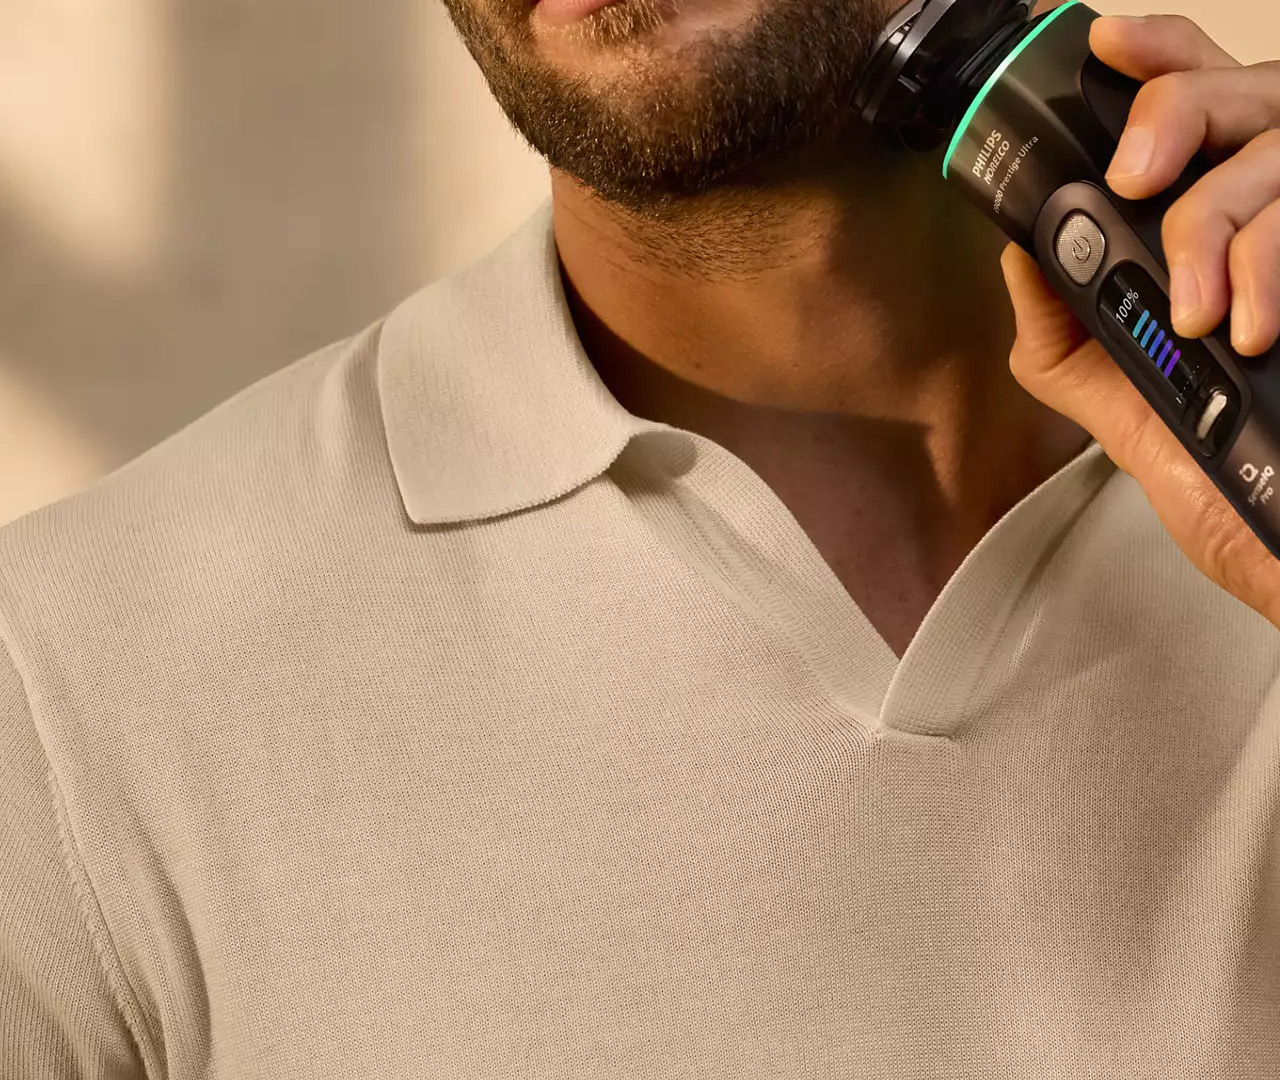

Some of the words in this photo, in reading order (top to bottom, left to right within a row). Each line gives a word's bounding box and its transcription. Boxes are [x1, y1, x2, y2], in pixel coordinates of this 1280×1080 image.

[972, 129, 1002, 178] PHILIPS
[983, 140, 1010, 185] NORELCO
[999, 156, 1022, 192] Prestige
[1017, 136, 1039, 158] Ultra
[1115, 288, 1139, 324] 100%
[1260, 486, 1274, 504] Pro
